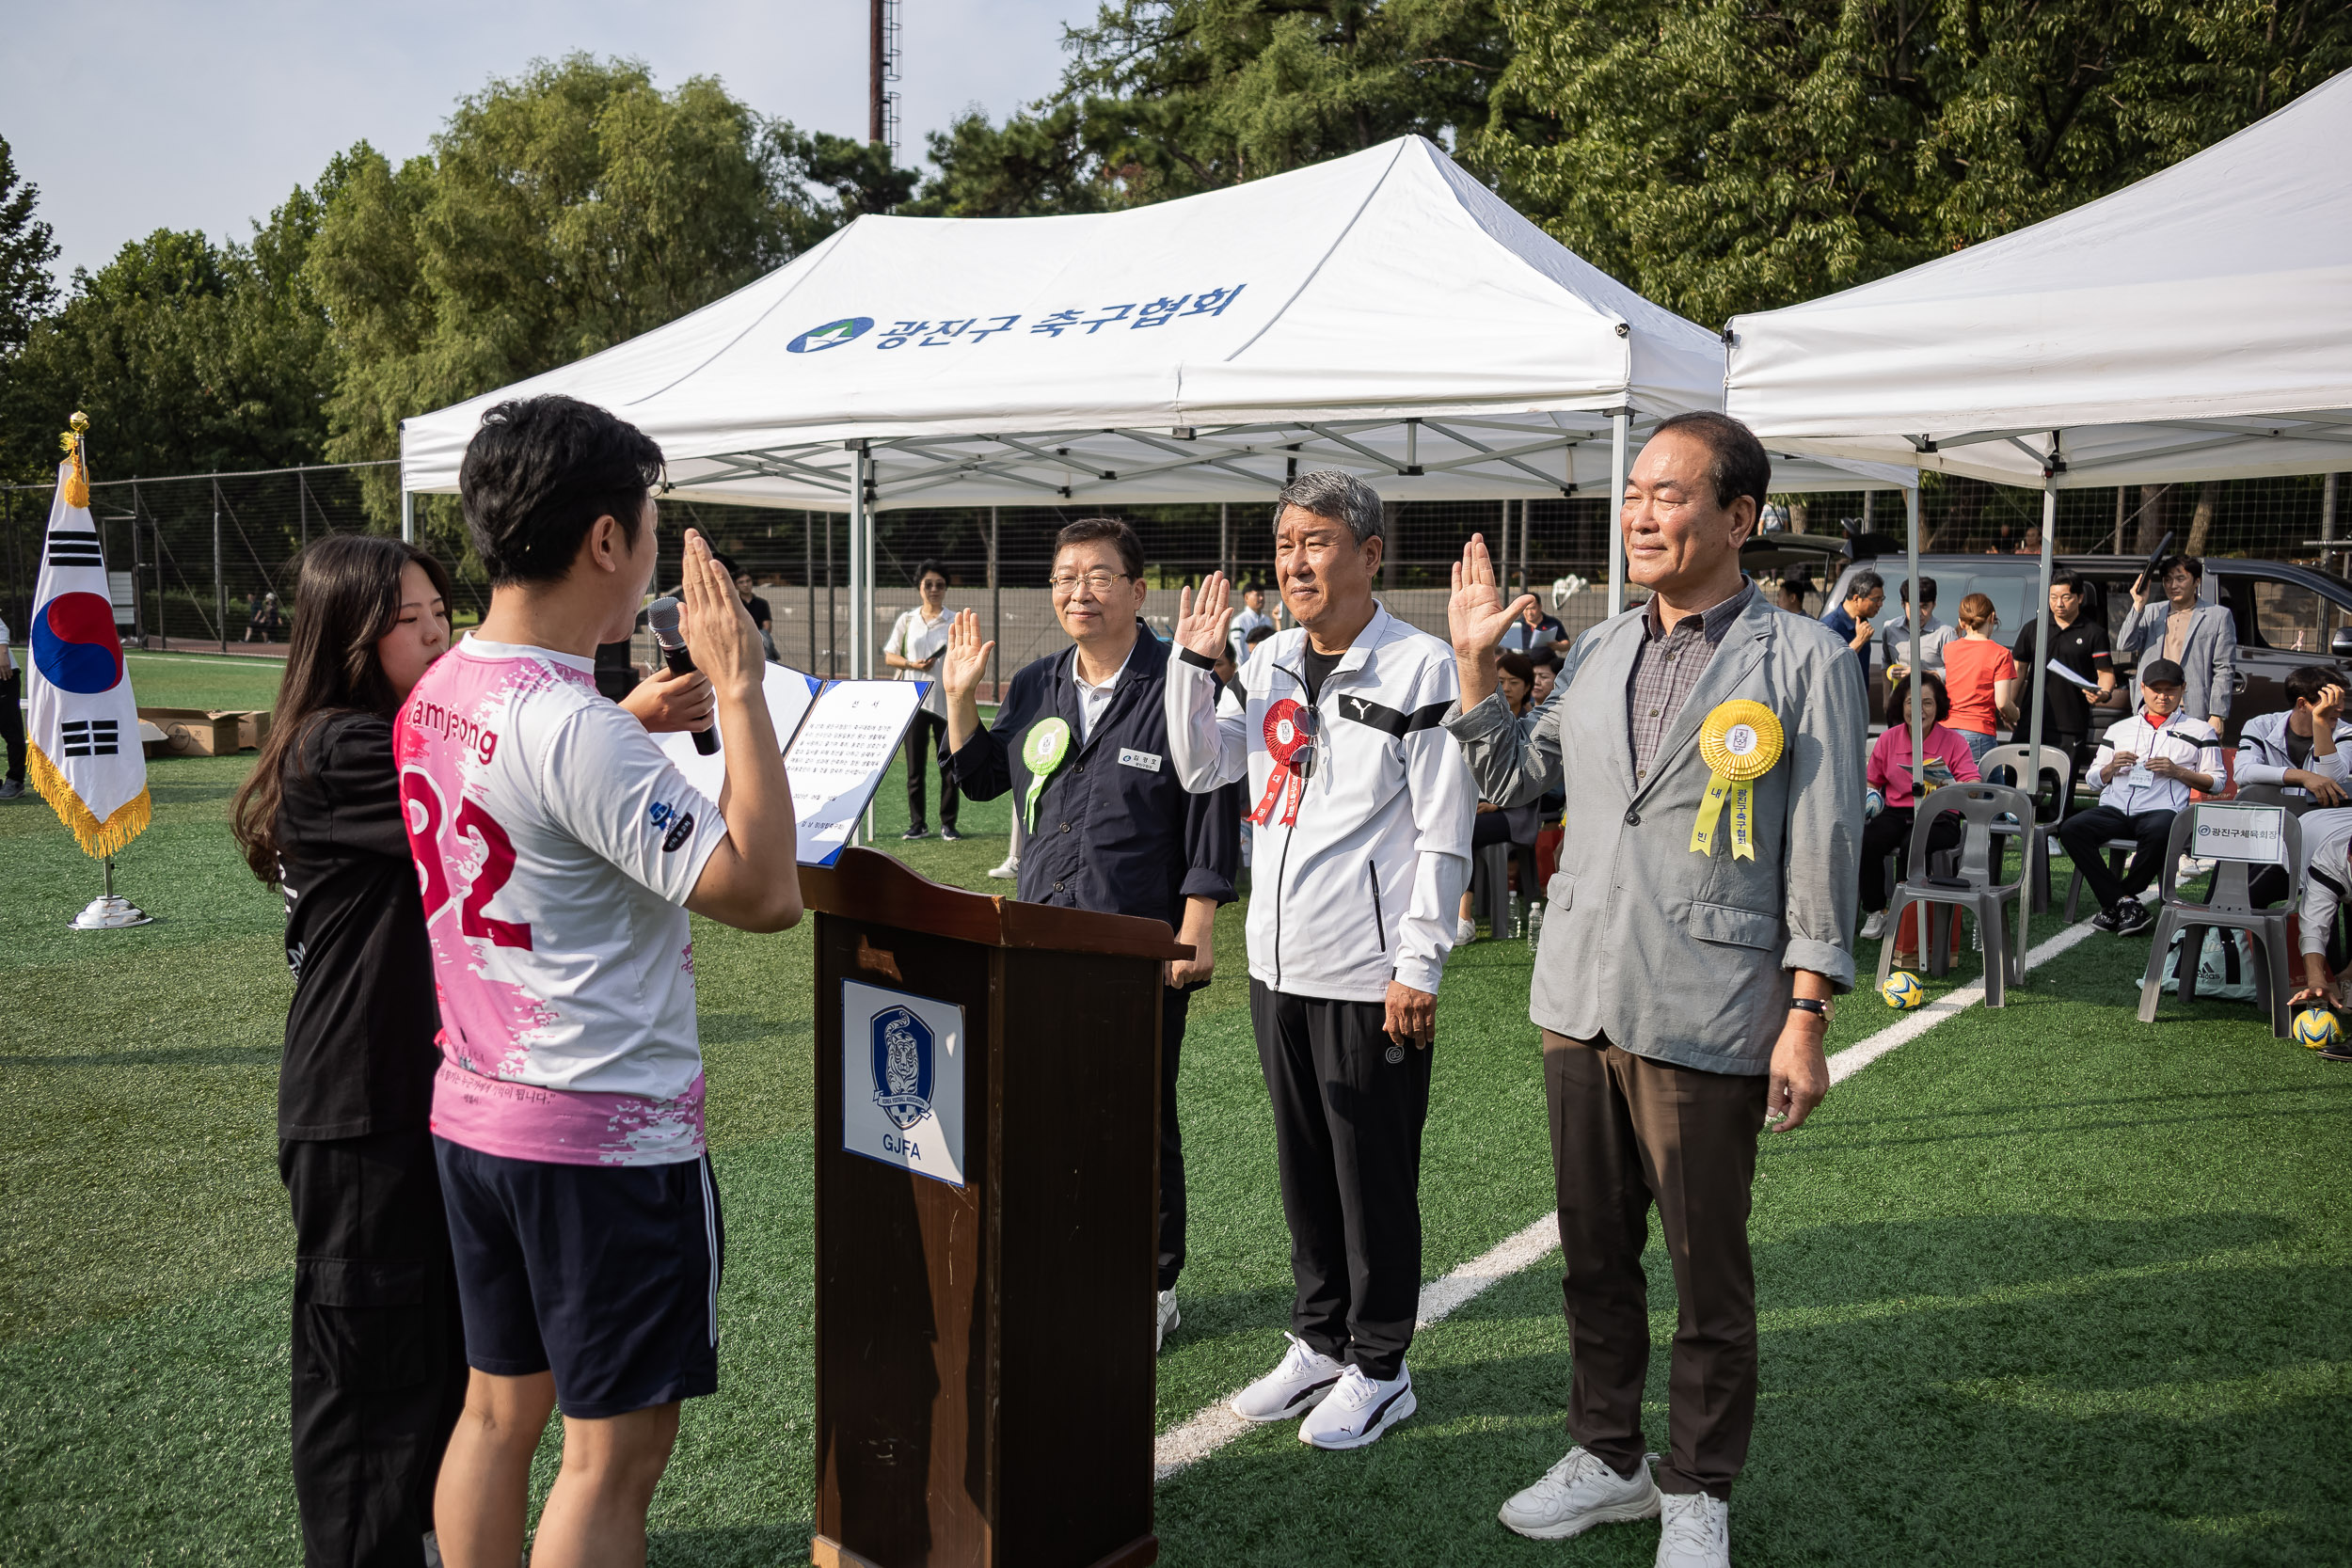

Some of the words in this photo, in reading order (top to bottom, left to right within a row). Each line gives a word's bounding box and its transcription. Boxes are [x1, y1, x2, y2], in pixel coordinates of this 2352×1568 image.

[877, 314, 1022, 350] 광진구
[1029, 283, 1247, 338] 축구협회
[407, 699, 499, 766] amjeong
[1736, 789, 1748, 846] 광진구축구협회
[2211, 827, 2278, 840] 광진구체육회장
[882, 1132, 921, 1161] GJFA
